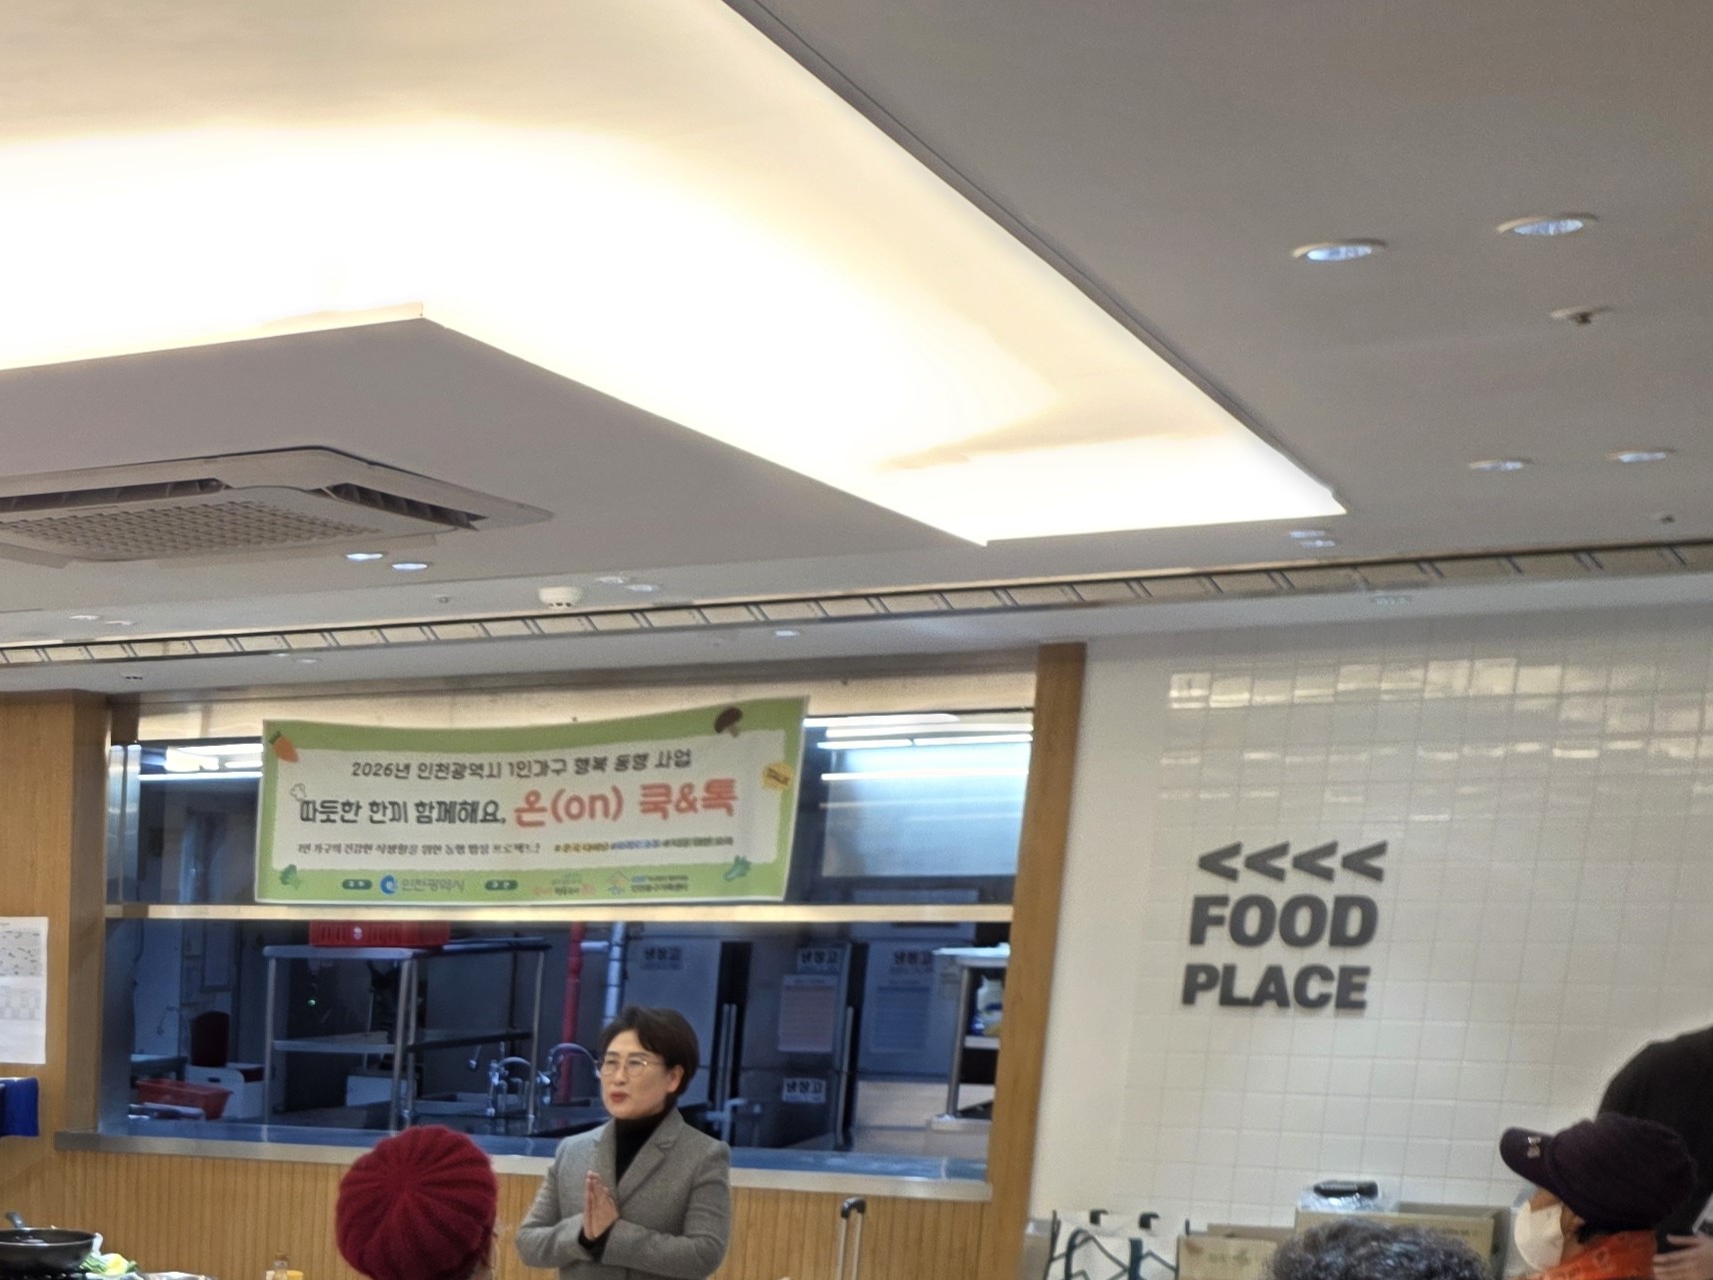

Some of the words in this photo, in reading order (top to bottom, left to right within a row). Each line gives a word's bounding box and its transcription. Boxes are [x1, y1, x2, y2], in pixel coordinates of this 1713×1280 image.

[351, 762, 411, 779] 2026년
[417, 761, 502, 779] 인천광역시
[508, 759, 567, 778] 1인가구
[574, 756, 608, 775] 행복
[614, 752, 649, 772] 동행
[654, 749, 692, 768] 사업
[299, 799, 362, 824] 따듯한
[368, 799, 409, 824] 한끼
[514, 784, 624, 828] 온(on)
[639, 778, 738, 820] 쿡&톡
[1189, 894, 1378, 947] FOOD
[1181, 963, 1371, 1009] PLACE
